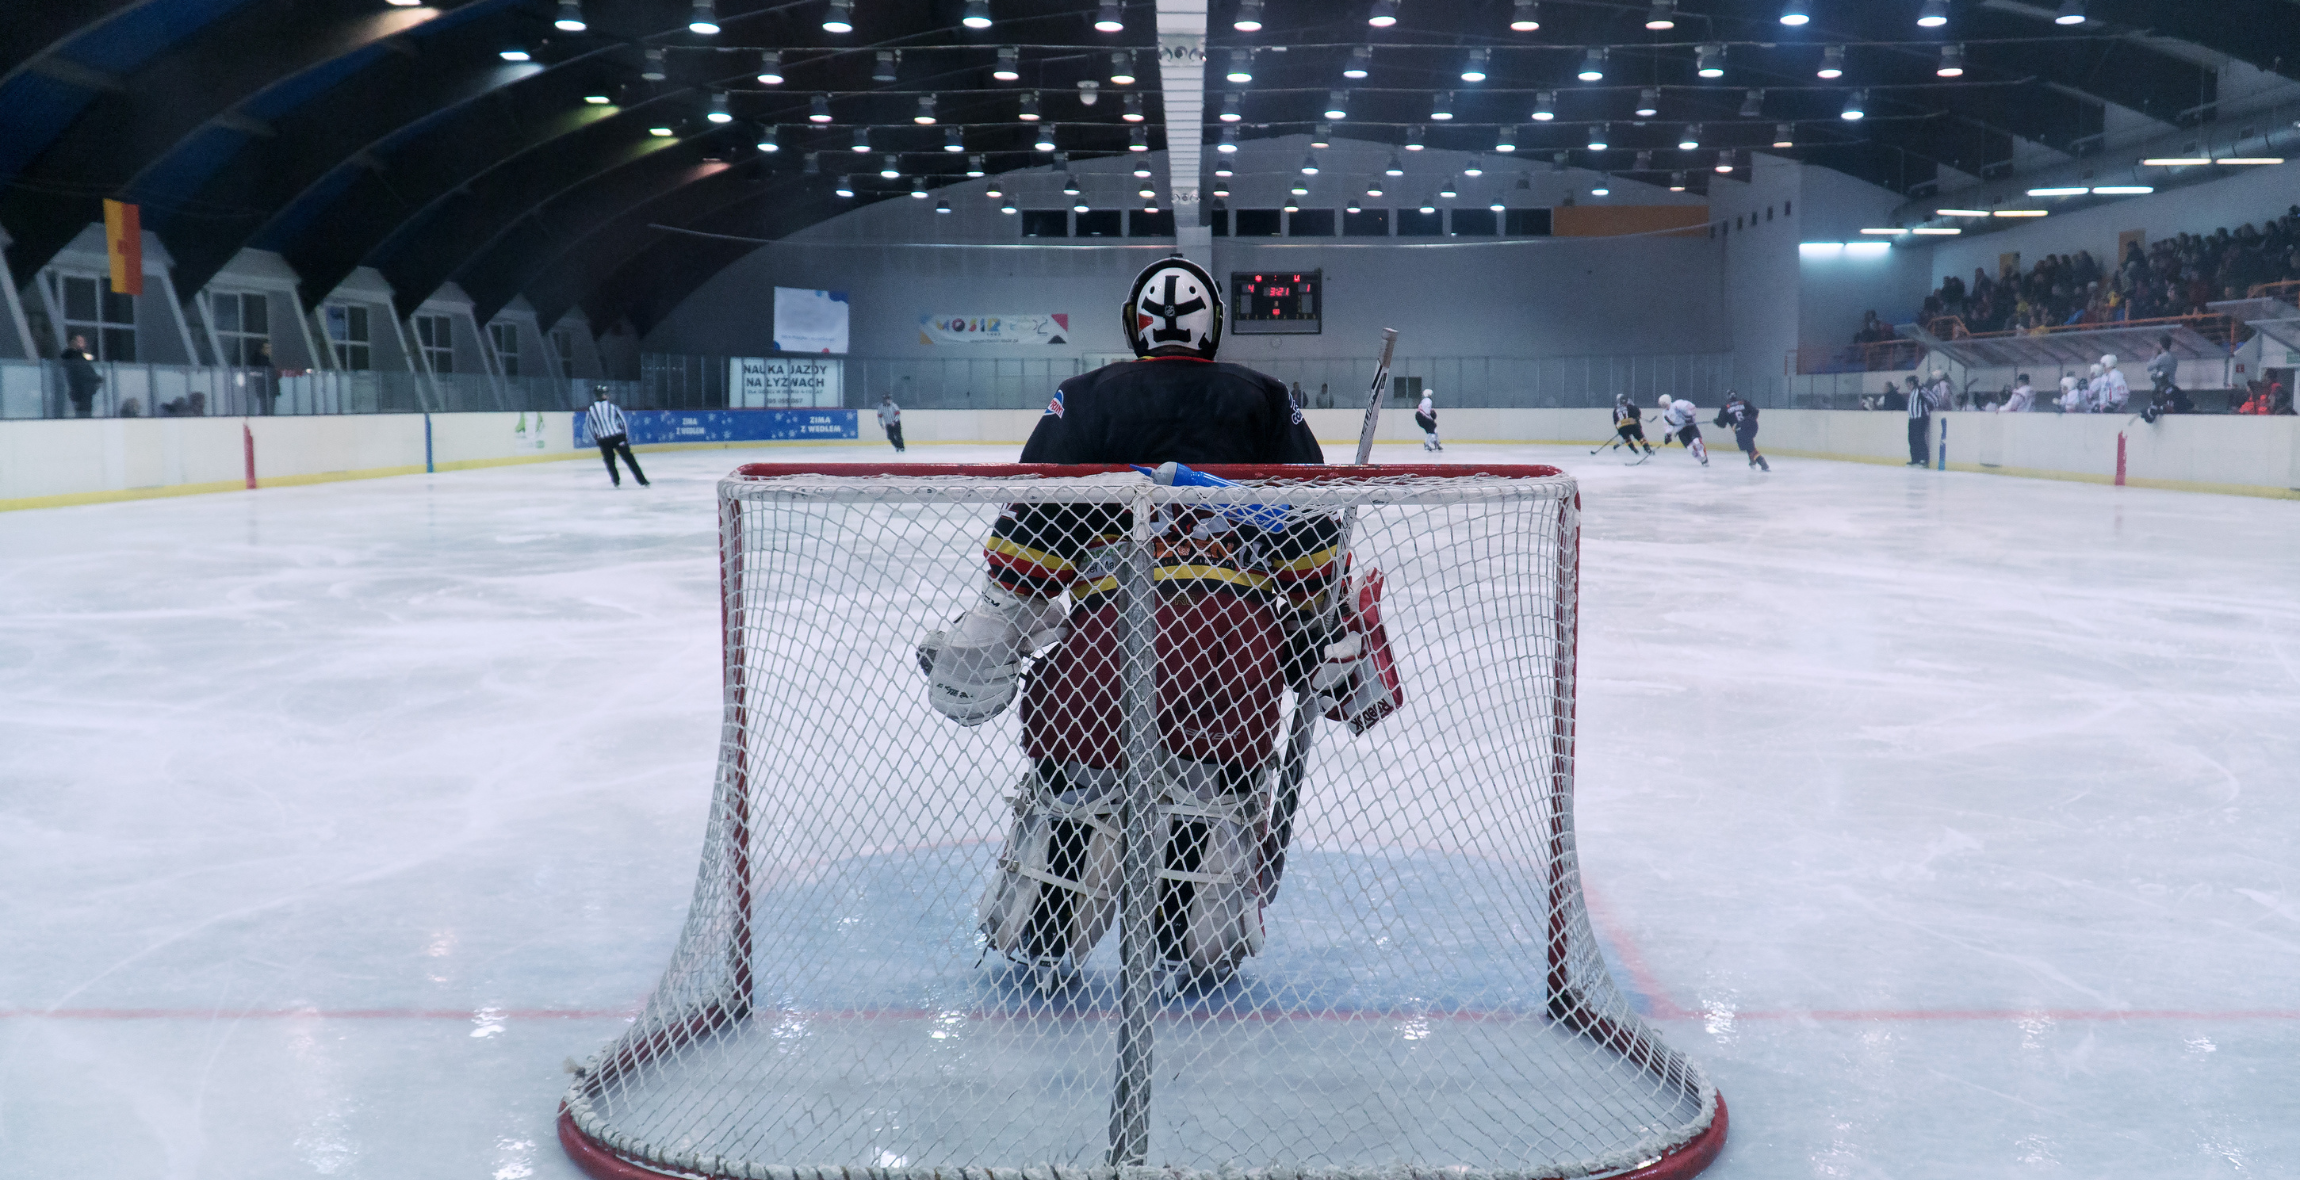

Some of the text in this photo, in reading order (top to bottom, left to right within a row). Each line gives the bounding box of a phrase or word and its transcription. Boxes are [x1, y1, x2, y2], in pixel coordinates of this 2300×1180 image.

[1269, 287, 1290, 297] 3:21
[743, 364, 828, 375] NAUKA JAZDY
[746, 377, 763, 387] NA
[809, 416, 831, 424] ZIMA
